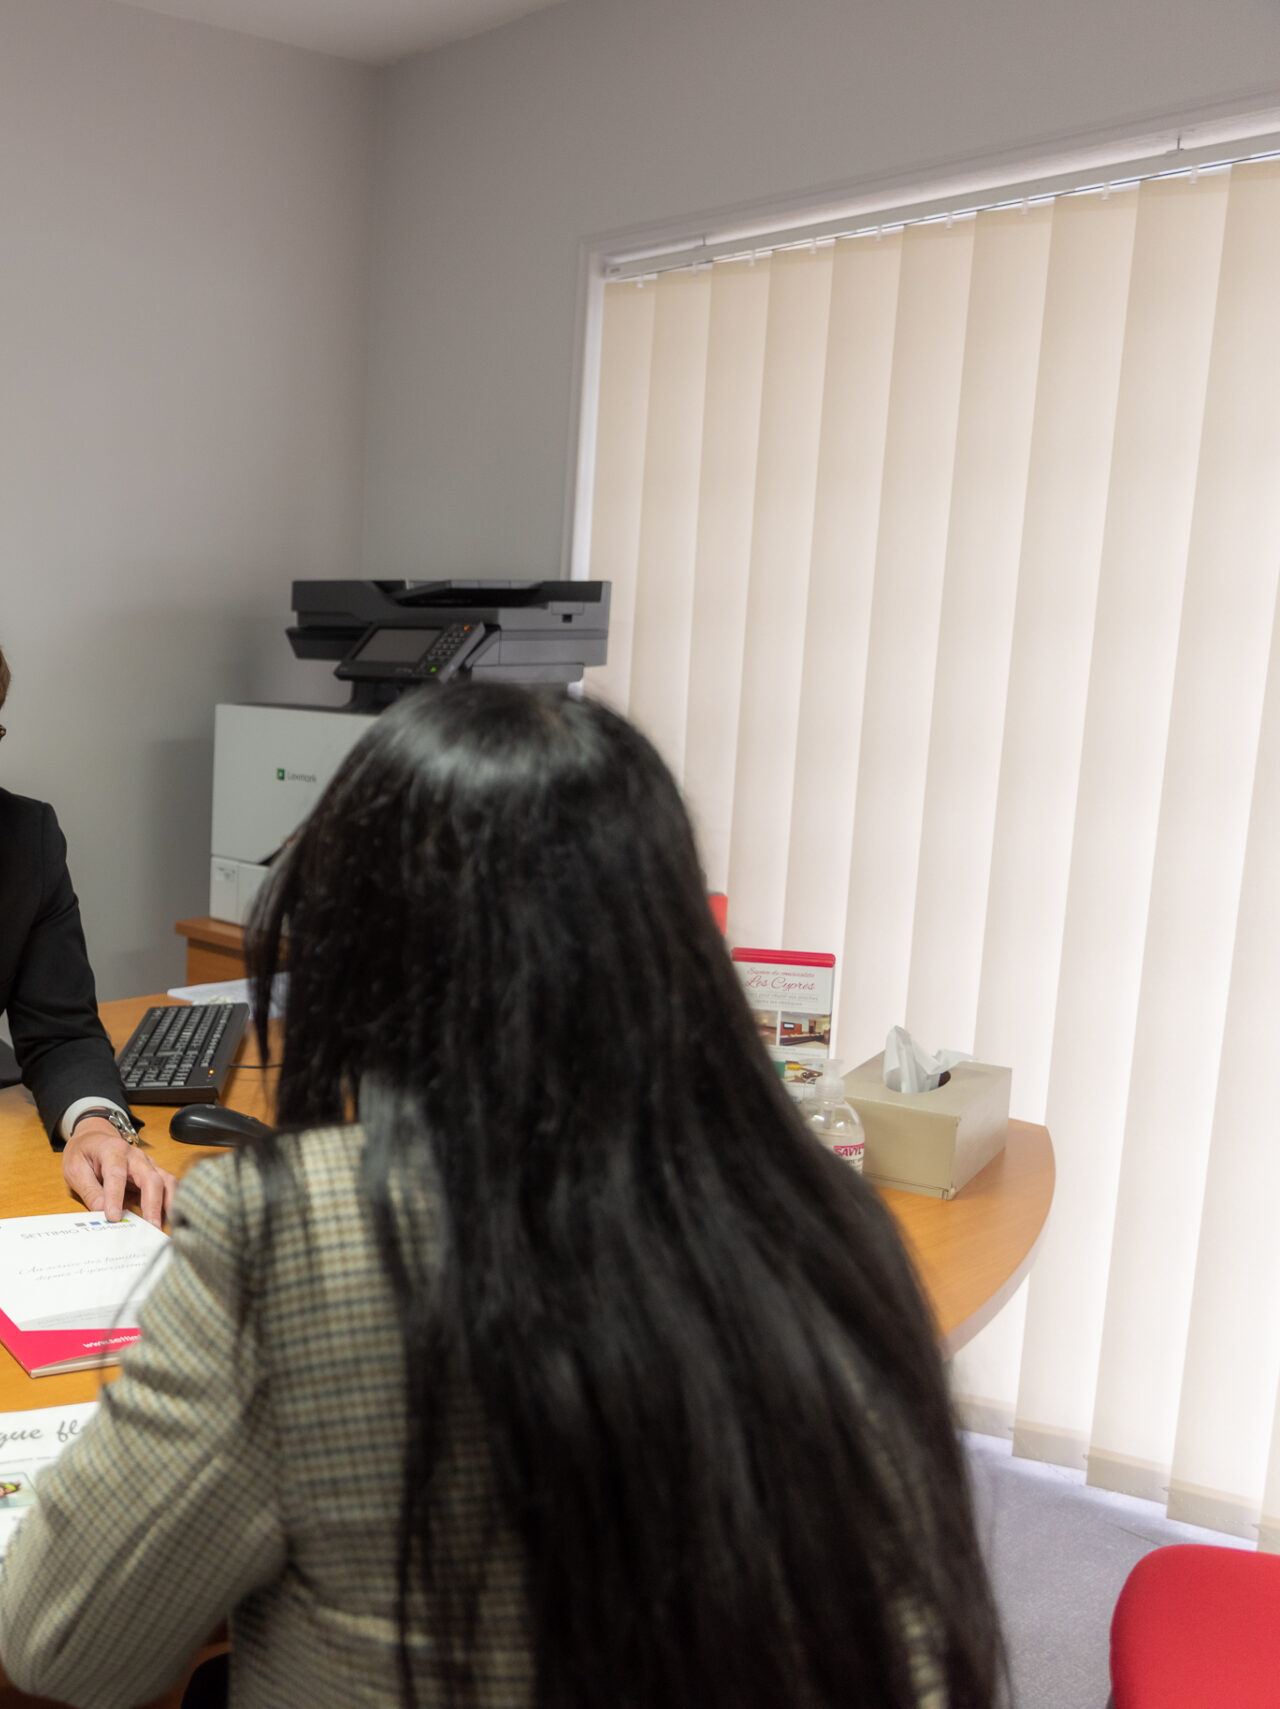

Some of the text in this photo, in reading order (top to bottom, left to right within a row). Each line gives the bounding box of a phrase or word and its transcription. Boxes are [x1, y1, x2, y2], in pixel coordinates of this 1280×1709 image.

[286, 770, 317, 783] Lexmark
[745, 975, 768, 988] Les
[19, 1227, 80, 1240] SETTIMIO
